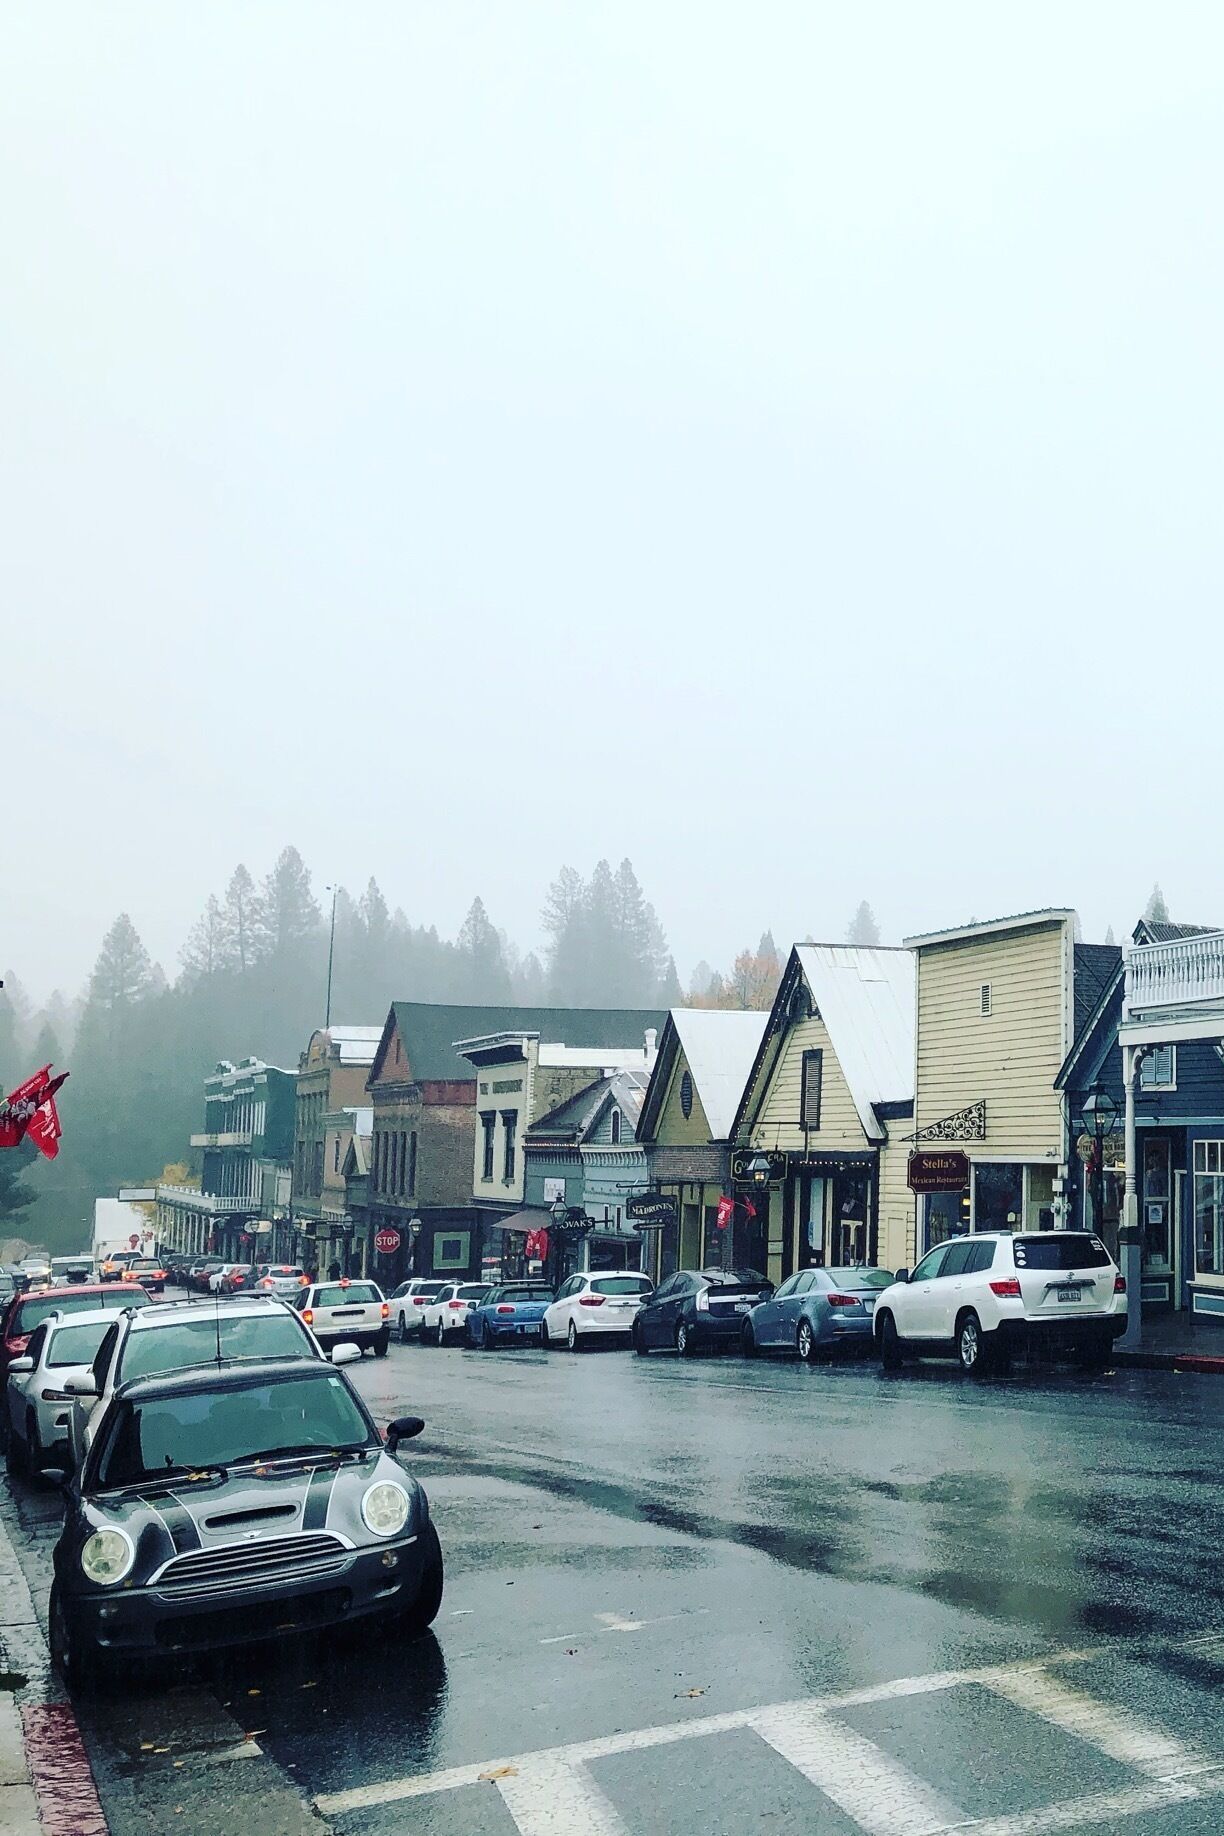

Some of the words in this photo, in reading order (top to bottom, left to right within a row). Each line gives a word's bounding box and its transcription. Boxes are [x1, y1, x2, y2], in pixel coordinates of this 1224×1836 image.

[922, 1158, 957, 1169] Stella's
[911, 1176, 936, 1184] Mexican
[936, 1175, 968, 1184] Restaurant
[376, 1236, 398, 1246] STOP
